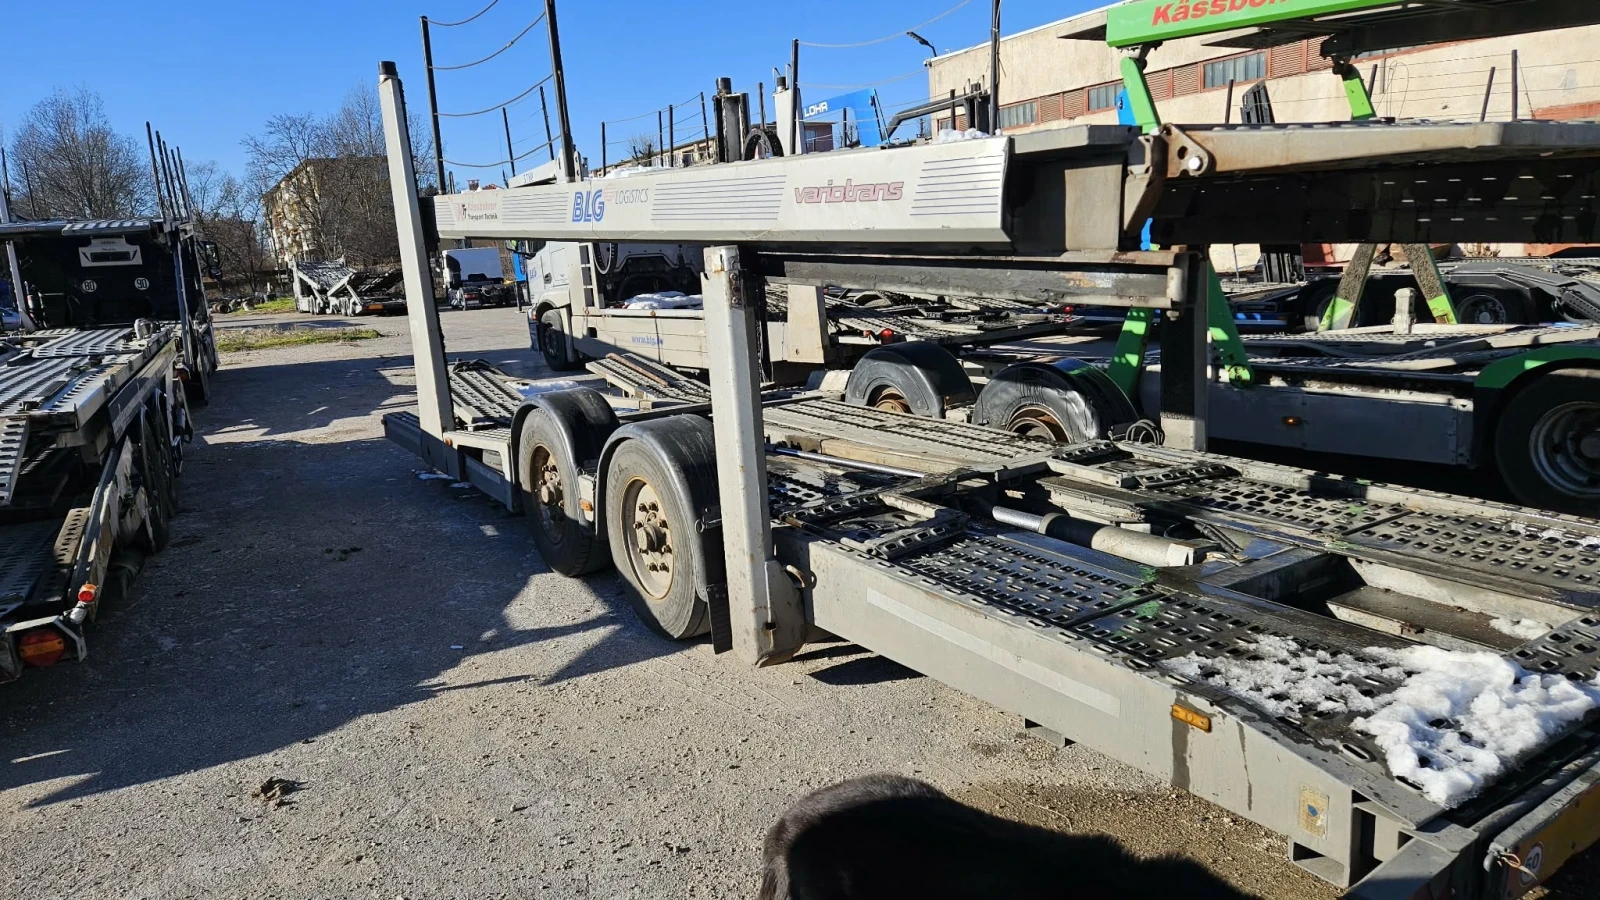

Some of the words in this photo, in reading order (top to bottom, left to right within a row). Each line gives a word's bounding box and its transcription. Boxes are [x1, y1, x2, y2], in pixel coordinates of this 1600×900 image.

[794, 178, 904, 204] variotrans
[572, 188, 605, 223] BLG
[614, 188, 649, 205] LOGISTICS
[84, 281, 95, 291] 80
[136, 278, 147, 289] 90
